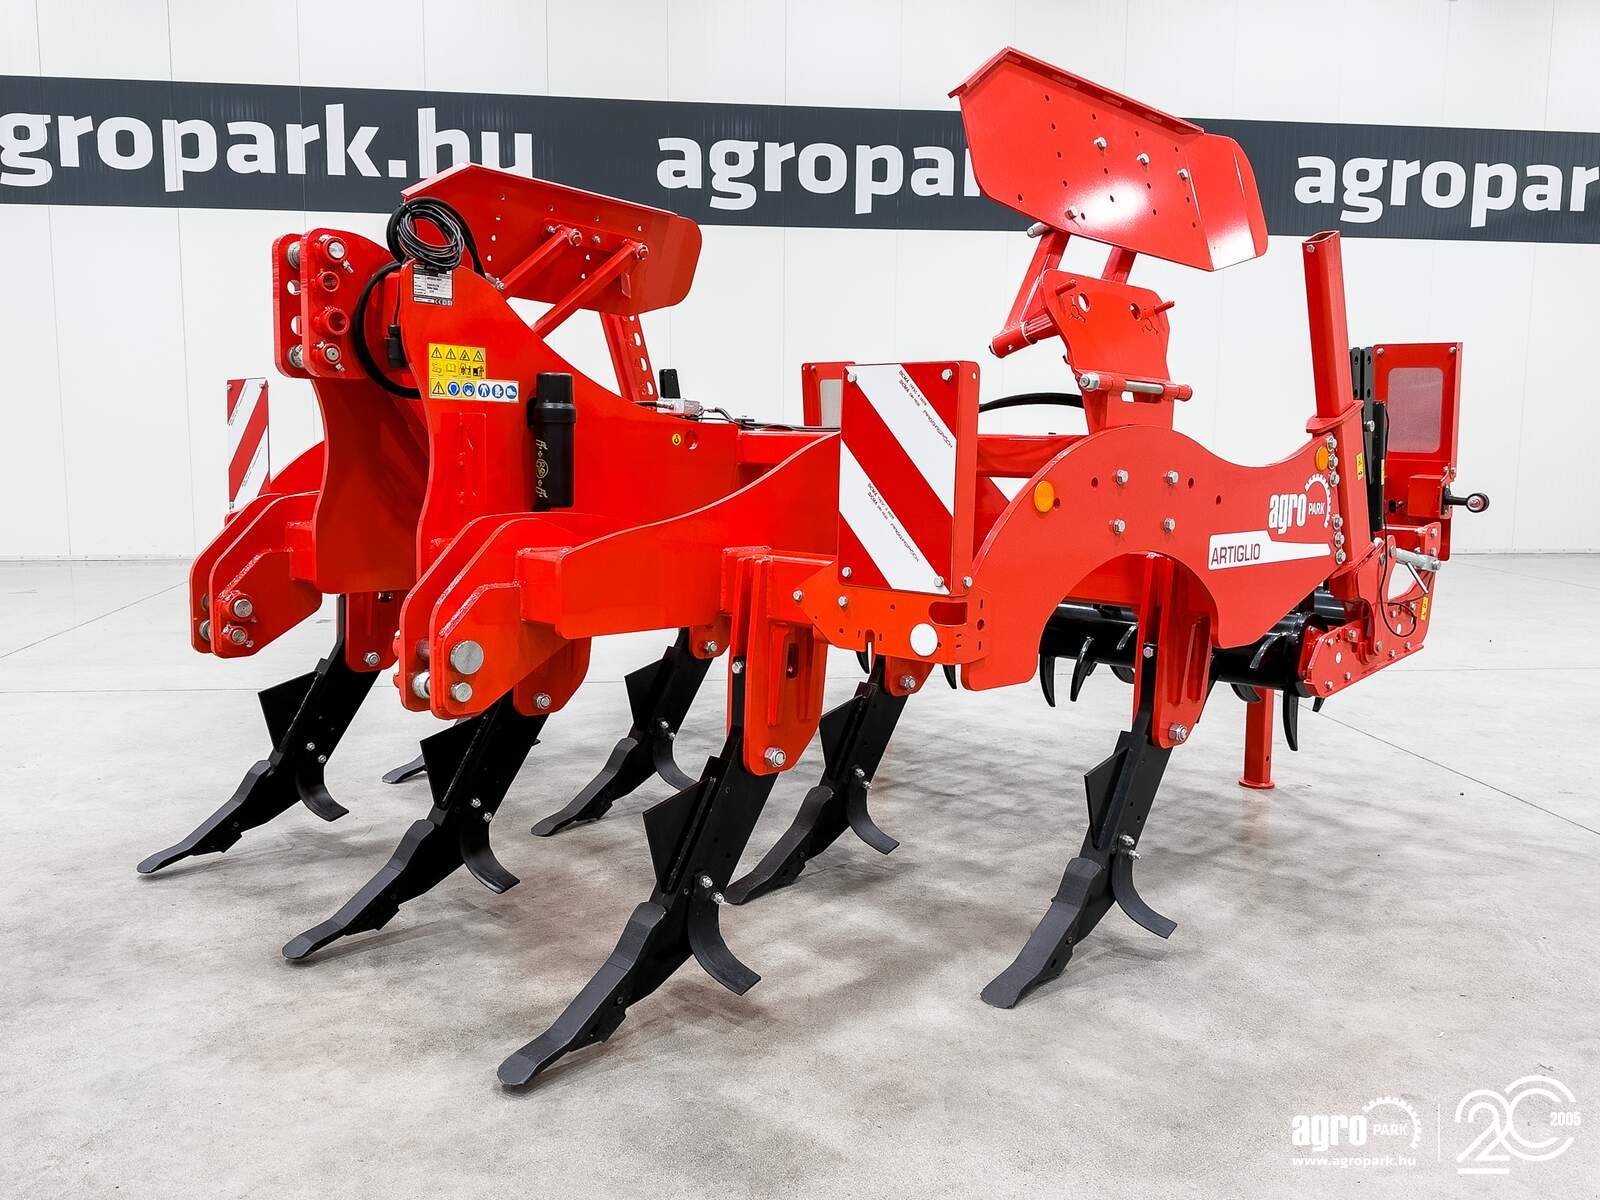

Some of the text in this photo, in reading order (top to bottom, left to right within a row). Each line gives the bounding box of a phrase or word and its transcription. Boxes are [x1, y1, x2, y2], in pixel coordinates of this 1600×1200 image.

[0, 103, 533, 192] gropark.hu
[1294, 156, 1600, 228] agropar
[1268, 493, 1326, 535] agro PARK
[1210, 543, 1261, 566] ARTIGLIO
